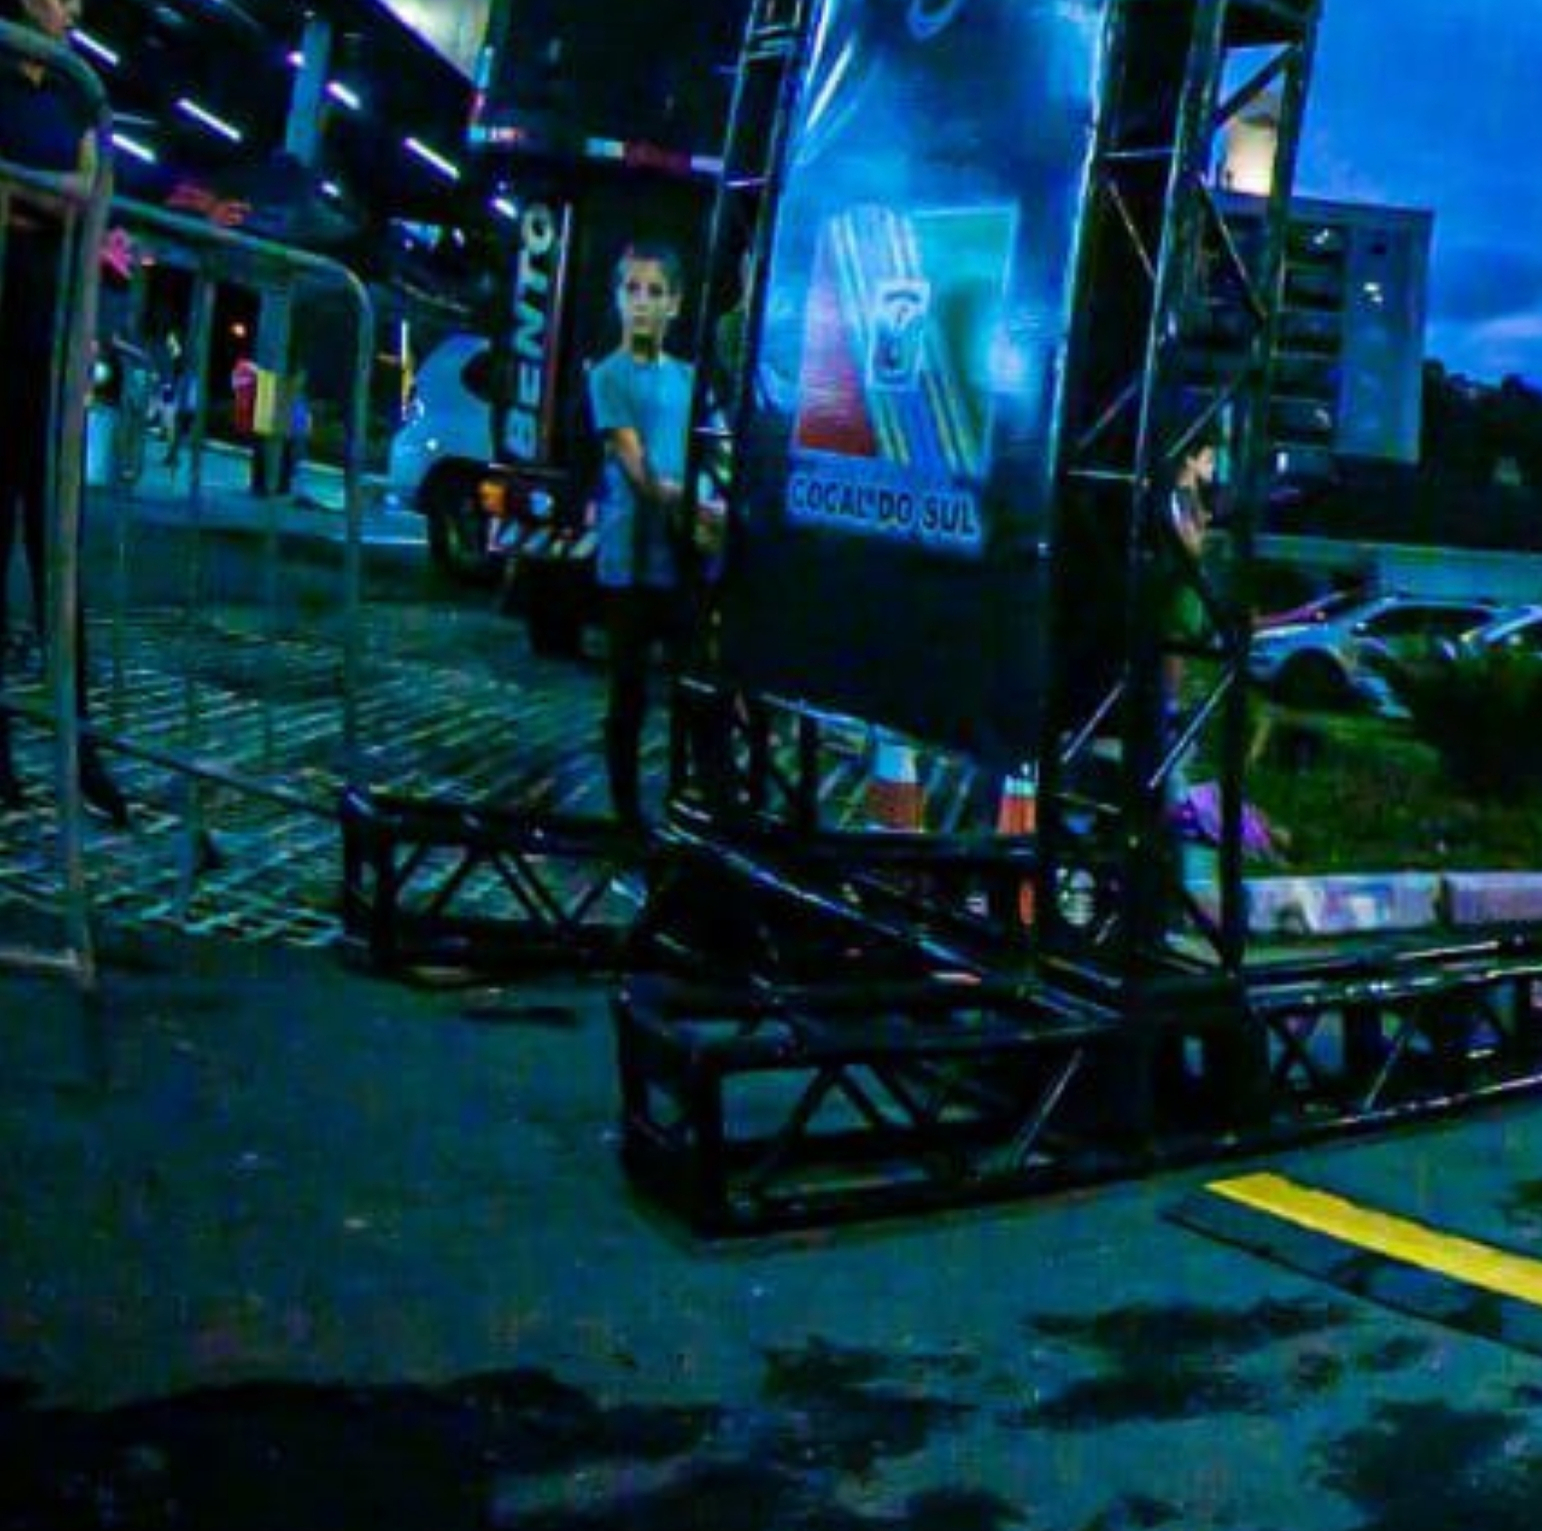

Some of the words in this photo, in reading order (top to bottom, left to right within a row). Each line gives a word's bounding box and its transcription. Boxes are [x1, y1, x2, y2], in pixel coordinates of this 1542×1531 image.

[506, 202, 553, 461] BENTO
[792, 477, 872, 518] COCAL
[878, 488, 914, 524] DO
[922, 496, 977, 537] SUL
